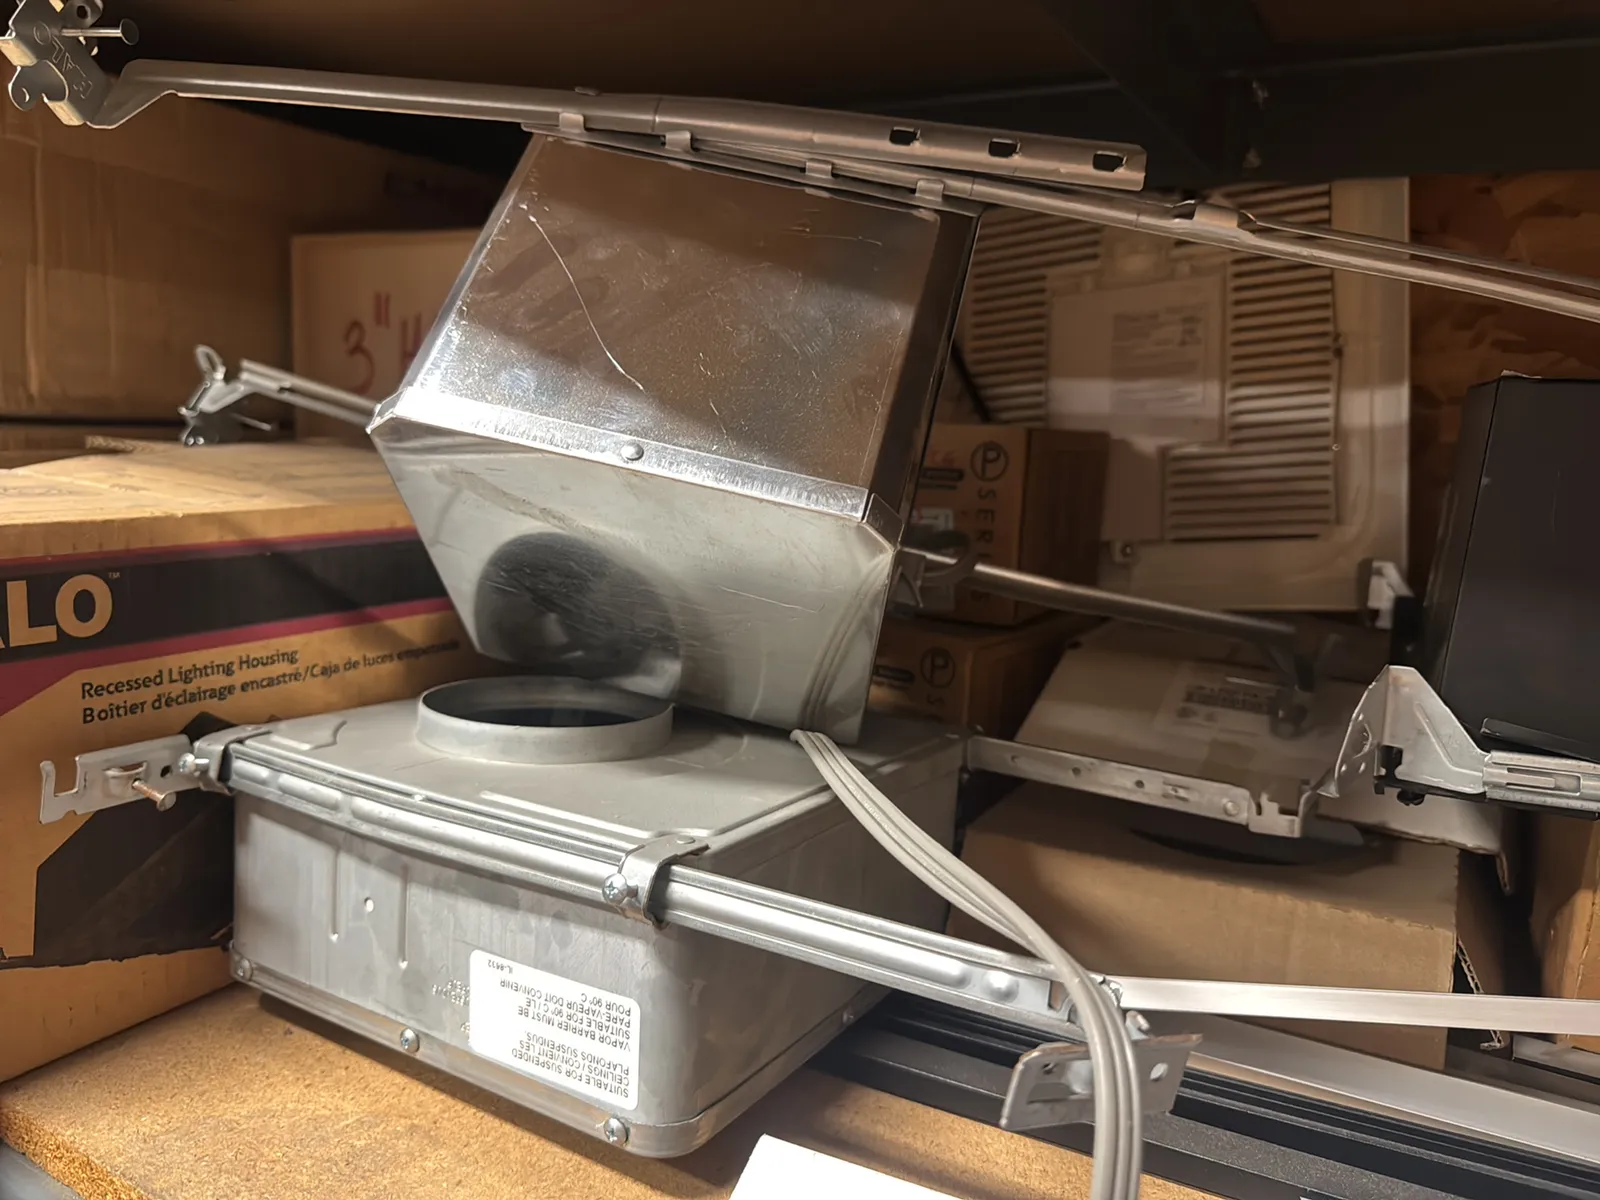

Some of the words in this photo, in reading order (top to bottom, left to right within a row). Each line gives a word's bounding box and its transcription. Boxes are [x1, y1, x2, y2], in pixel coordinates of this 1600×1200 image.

[0, 573, 113, 650] LO
[81, 669, 164, 700] Recessed
[168, 660, 235, 685] Lighting
[238, 649, 299, 671] Housing
[82, 699, 148, 724] Boîtier
[151, 682, 236, 711] d'éclairage
[343, 655, 361, 672] de
[363, 652, 395, 668] luces
[500, 978, 542, 1000] CONVENIR
[544, 992, 564, 1007] DOIT
[580, 993, 588, 1003] C
[517, 1005, 530, 1018] BE
[525, 997, 536, 1009] LE
[605, 1000, 632, 1017] POUR
[531, 1010, 555, 1026] MUST
[565, 1010, 584, 1026] FOR
[566, 999, 631, 1029] PARE-VAPEUR
[556, 1020, 596, 1041] BARRIER
[586, 1017, 631, 1040] SUITABLE
[519, 1039, 536, 1054] LES
[598, 1032, 631, 1053] VAPOR
[512, 1048, 562, 1075] SUSPENDED
[537, 1046, 581, 1069] CONVIENT
[581, 1051, 630, 1076] PLAFONDS
[565, 1067, 583, 1082] FOR
[588, 1064, 630, 1087] CEILINGS
[585, 1074, 629, 1098] SUITABLE
